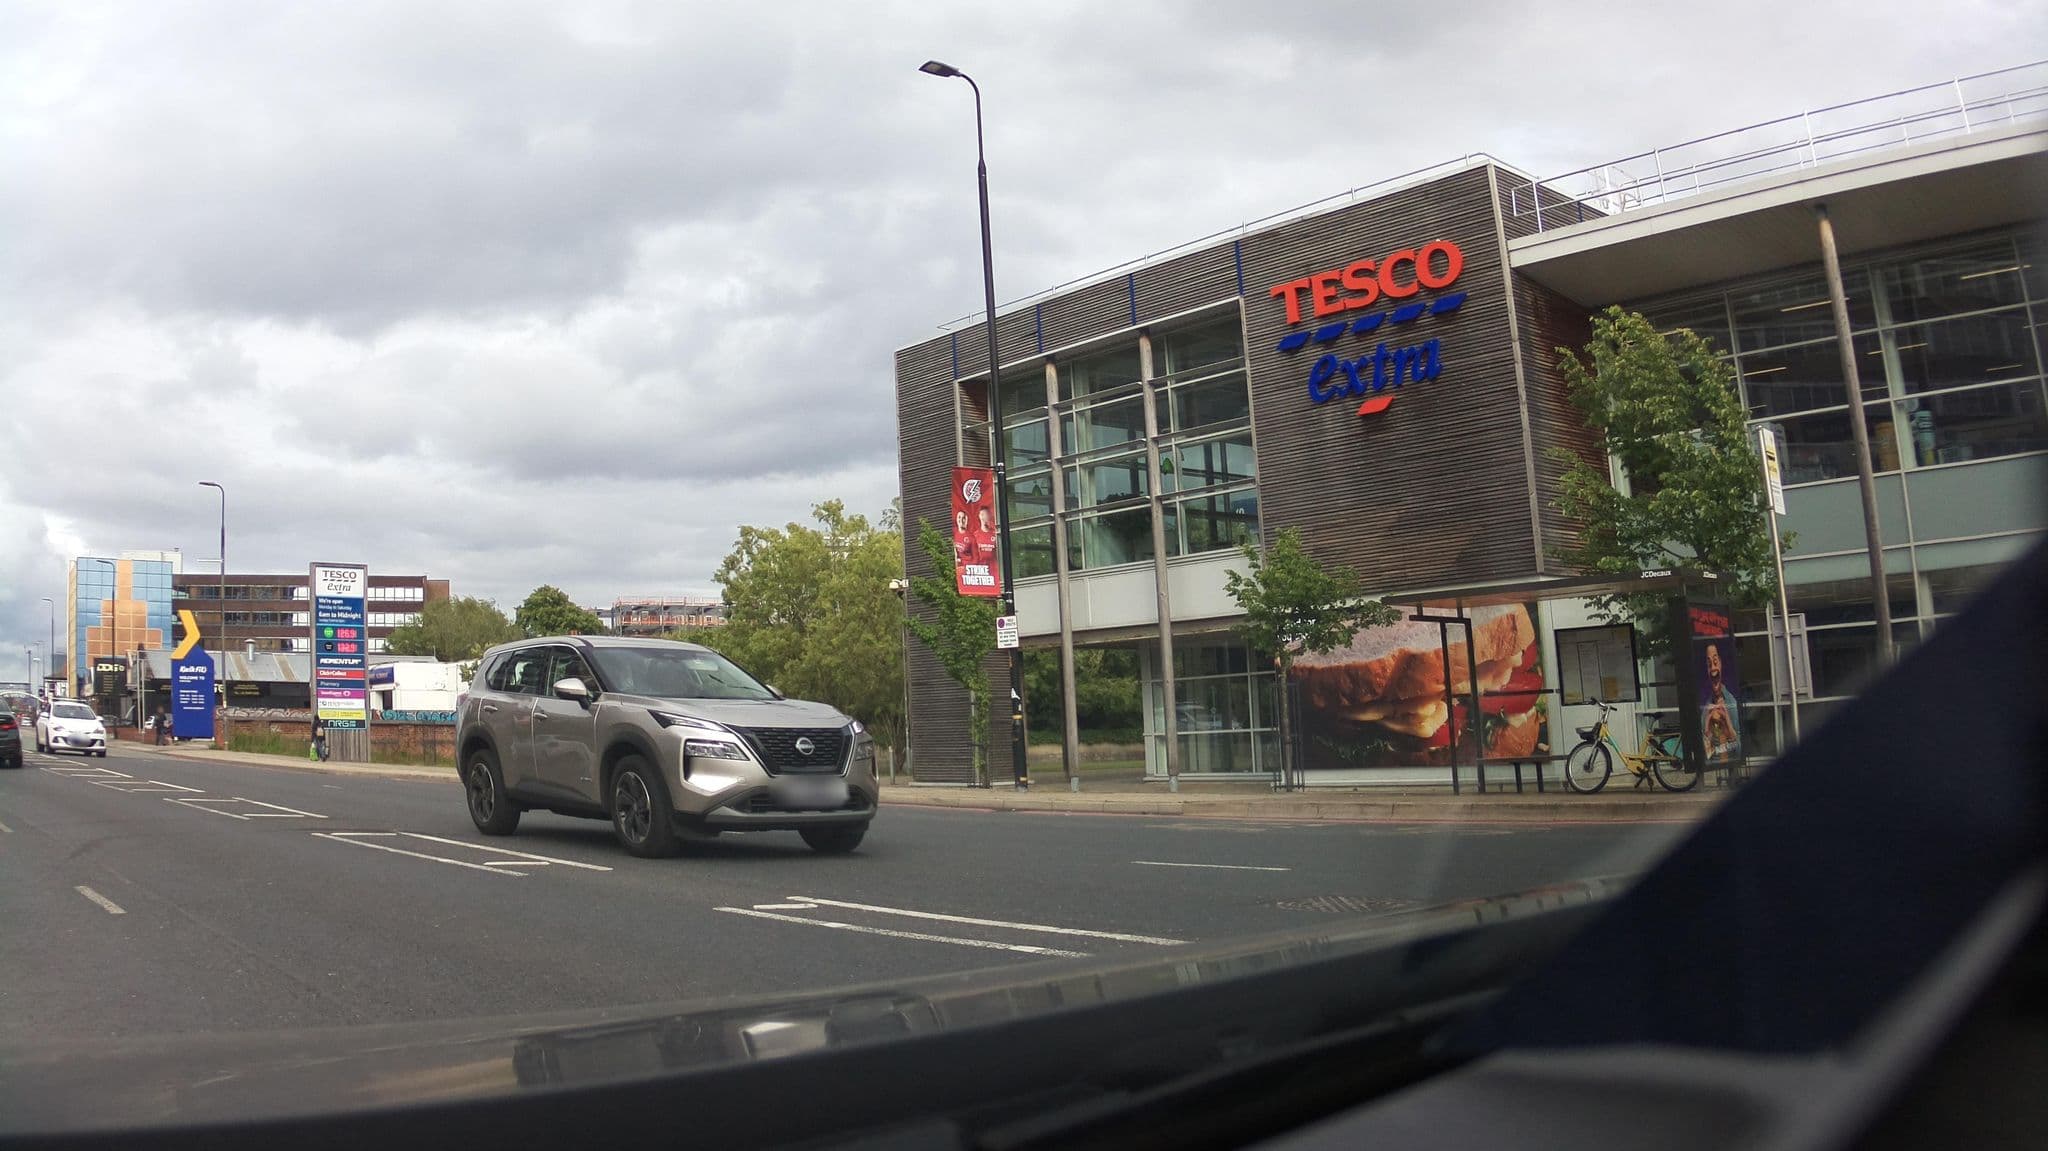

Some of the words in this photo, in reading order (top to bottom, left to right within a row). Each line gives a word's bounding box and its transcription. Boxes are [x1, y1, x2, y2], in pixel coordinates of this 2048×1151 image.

[1270, 239, 1464, 325] TESCO
[1308, 337, 1443, 405] extra
[322, 570, 357, 579] TESCO
[965, 564, 990, 576] STRIKE
[1640, 571, 1671, 579] JCDecaux
[961, 574, 995, 586] TOGETHER
[327, 582, 352, 592] extra
[337, 611, 362, 620] Midnight
